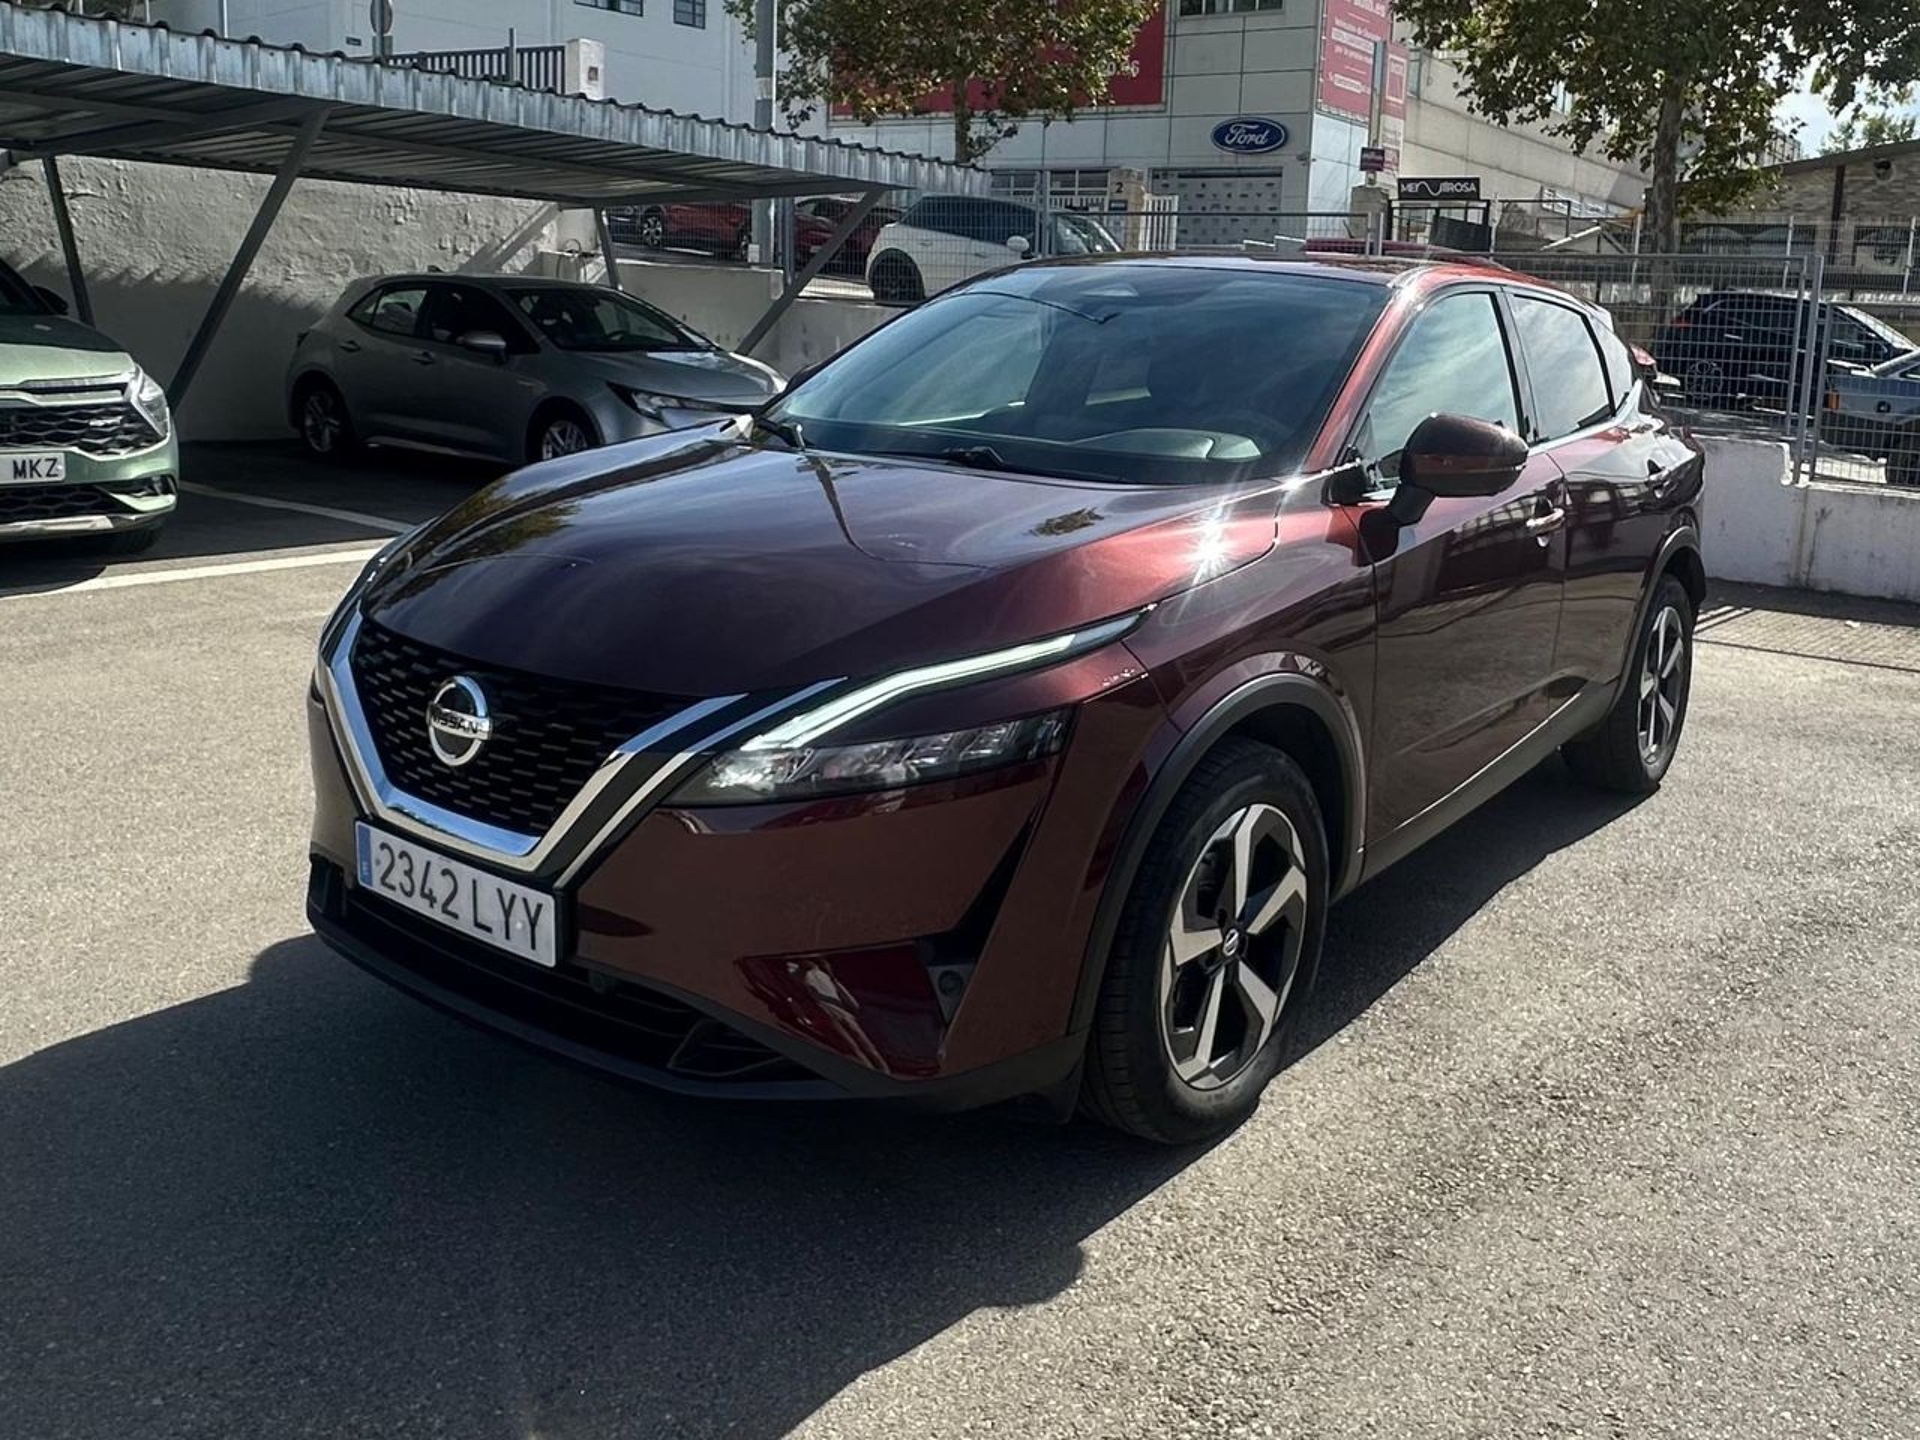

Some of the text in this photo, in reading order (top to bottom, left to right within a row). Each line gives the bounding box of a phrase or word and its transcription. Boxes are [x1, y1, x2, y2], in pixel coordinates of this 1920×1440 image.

[1225, 124, 1270, 145] Ford
[1115, 181, 1124, 193] 2
[13, 458, 59, 480] MKZ
[432, 711, 479, 734] NISSAN
[379, 842, 543, 951] 2342 LYY
